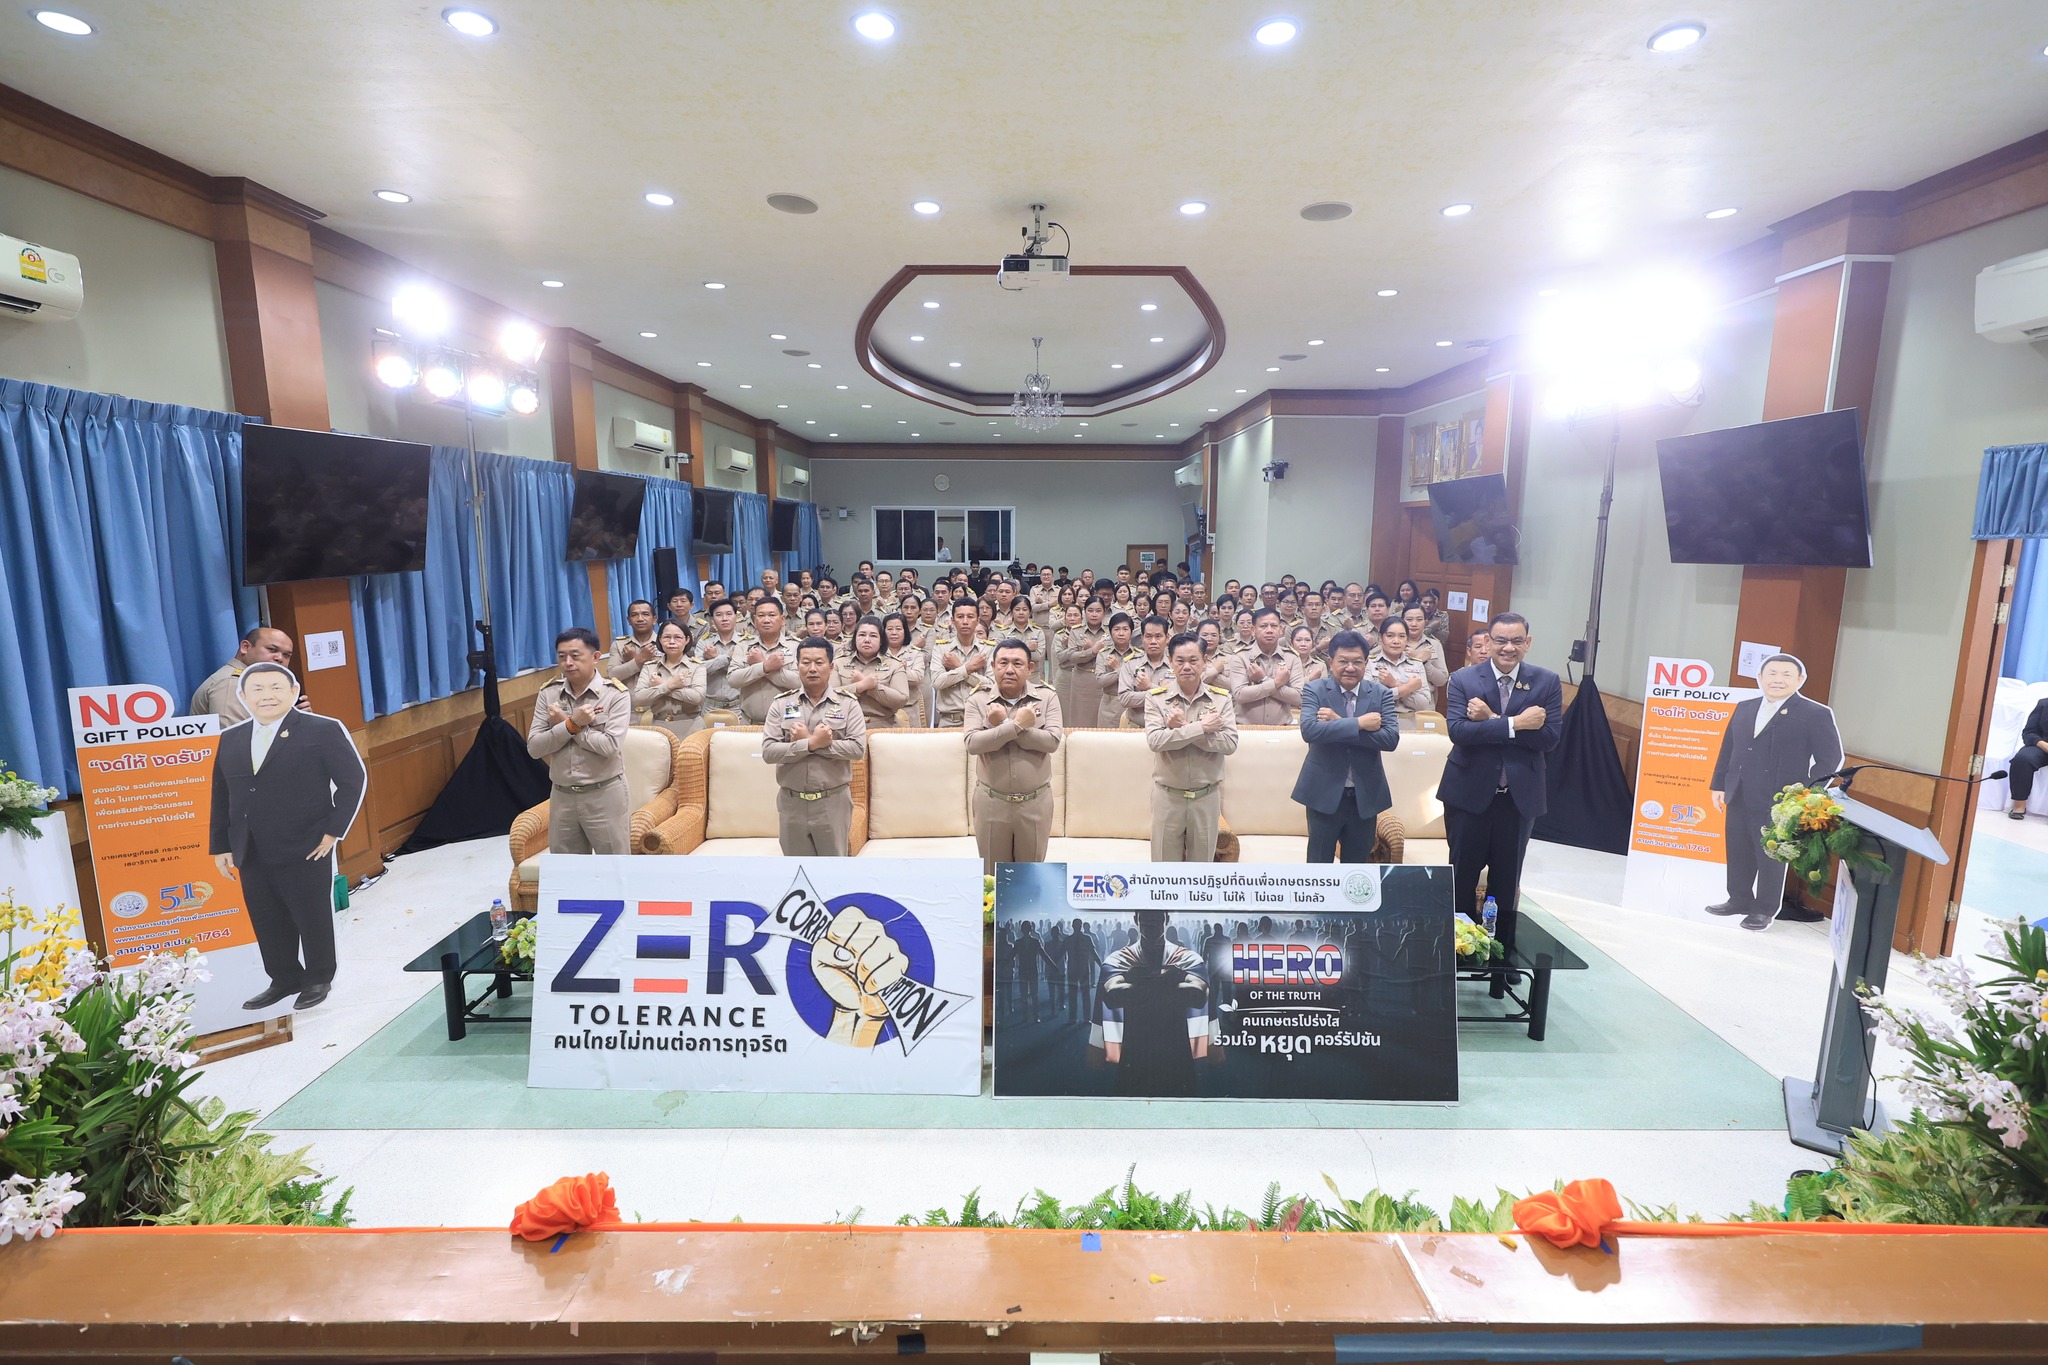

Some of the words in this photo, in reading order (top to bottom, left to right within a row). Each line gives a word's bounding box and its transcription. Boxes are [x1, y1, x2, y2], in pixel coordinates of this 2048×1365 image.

[1653, 662, 1708, 688] NO
[1652, 687, 1680, 698] GIFT
[1684, 690, 1730, 701] POLICY
[79, 691, 167, 728] NO
[83, 729, 129, 745] GIFT
[137, 722, 207, 741] POLICY
[1687, 844, 1711, 853] 1764
[1129, 872, 1341, 889] สำนักงานการปฏิรูปที่ดินเพื่อเกษตรกรรม
[1150, 890, 1179, 901] ไม่โกง
[1189, 891, 1213, 902] ไม่รับ
[1223, 891, 1246, 902] ไม่ให้
[1255, 891, 1284, 903] ไม่เฉย
[1294, 892, 1325, 903] ไม่กลัว
[196, 928, 232, 942] 1764
[1232, 943, 1343, 986] HERO
[1249, 990, 1264, 1000] OF
[1266, 991, 1285, 1000] THE
[1287, 991, 1321, 1001] TRUTH
[569, 1004, 766, 1028] TOLERANCE
[1242, 1014, 1340, 1027] คนเกษตรโปร่งใส
[554, 1029, 788, 1058] คนไทยไม่ทนต่อการทุจริต
[1213, 1030, 1256, 1046] ร่วมใจ
[1260, 1034, 1312, 1061] หยุด
[1314, 1031, 1381, 1047] คอร์รัปชัน
